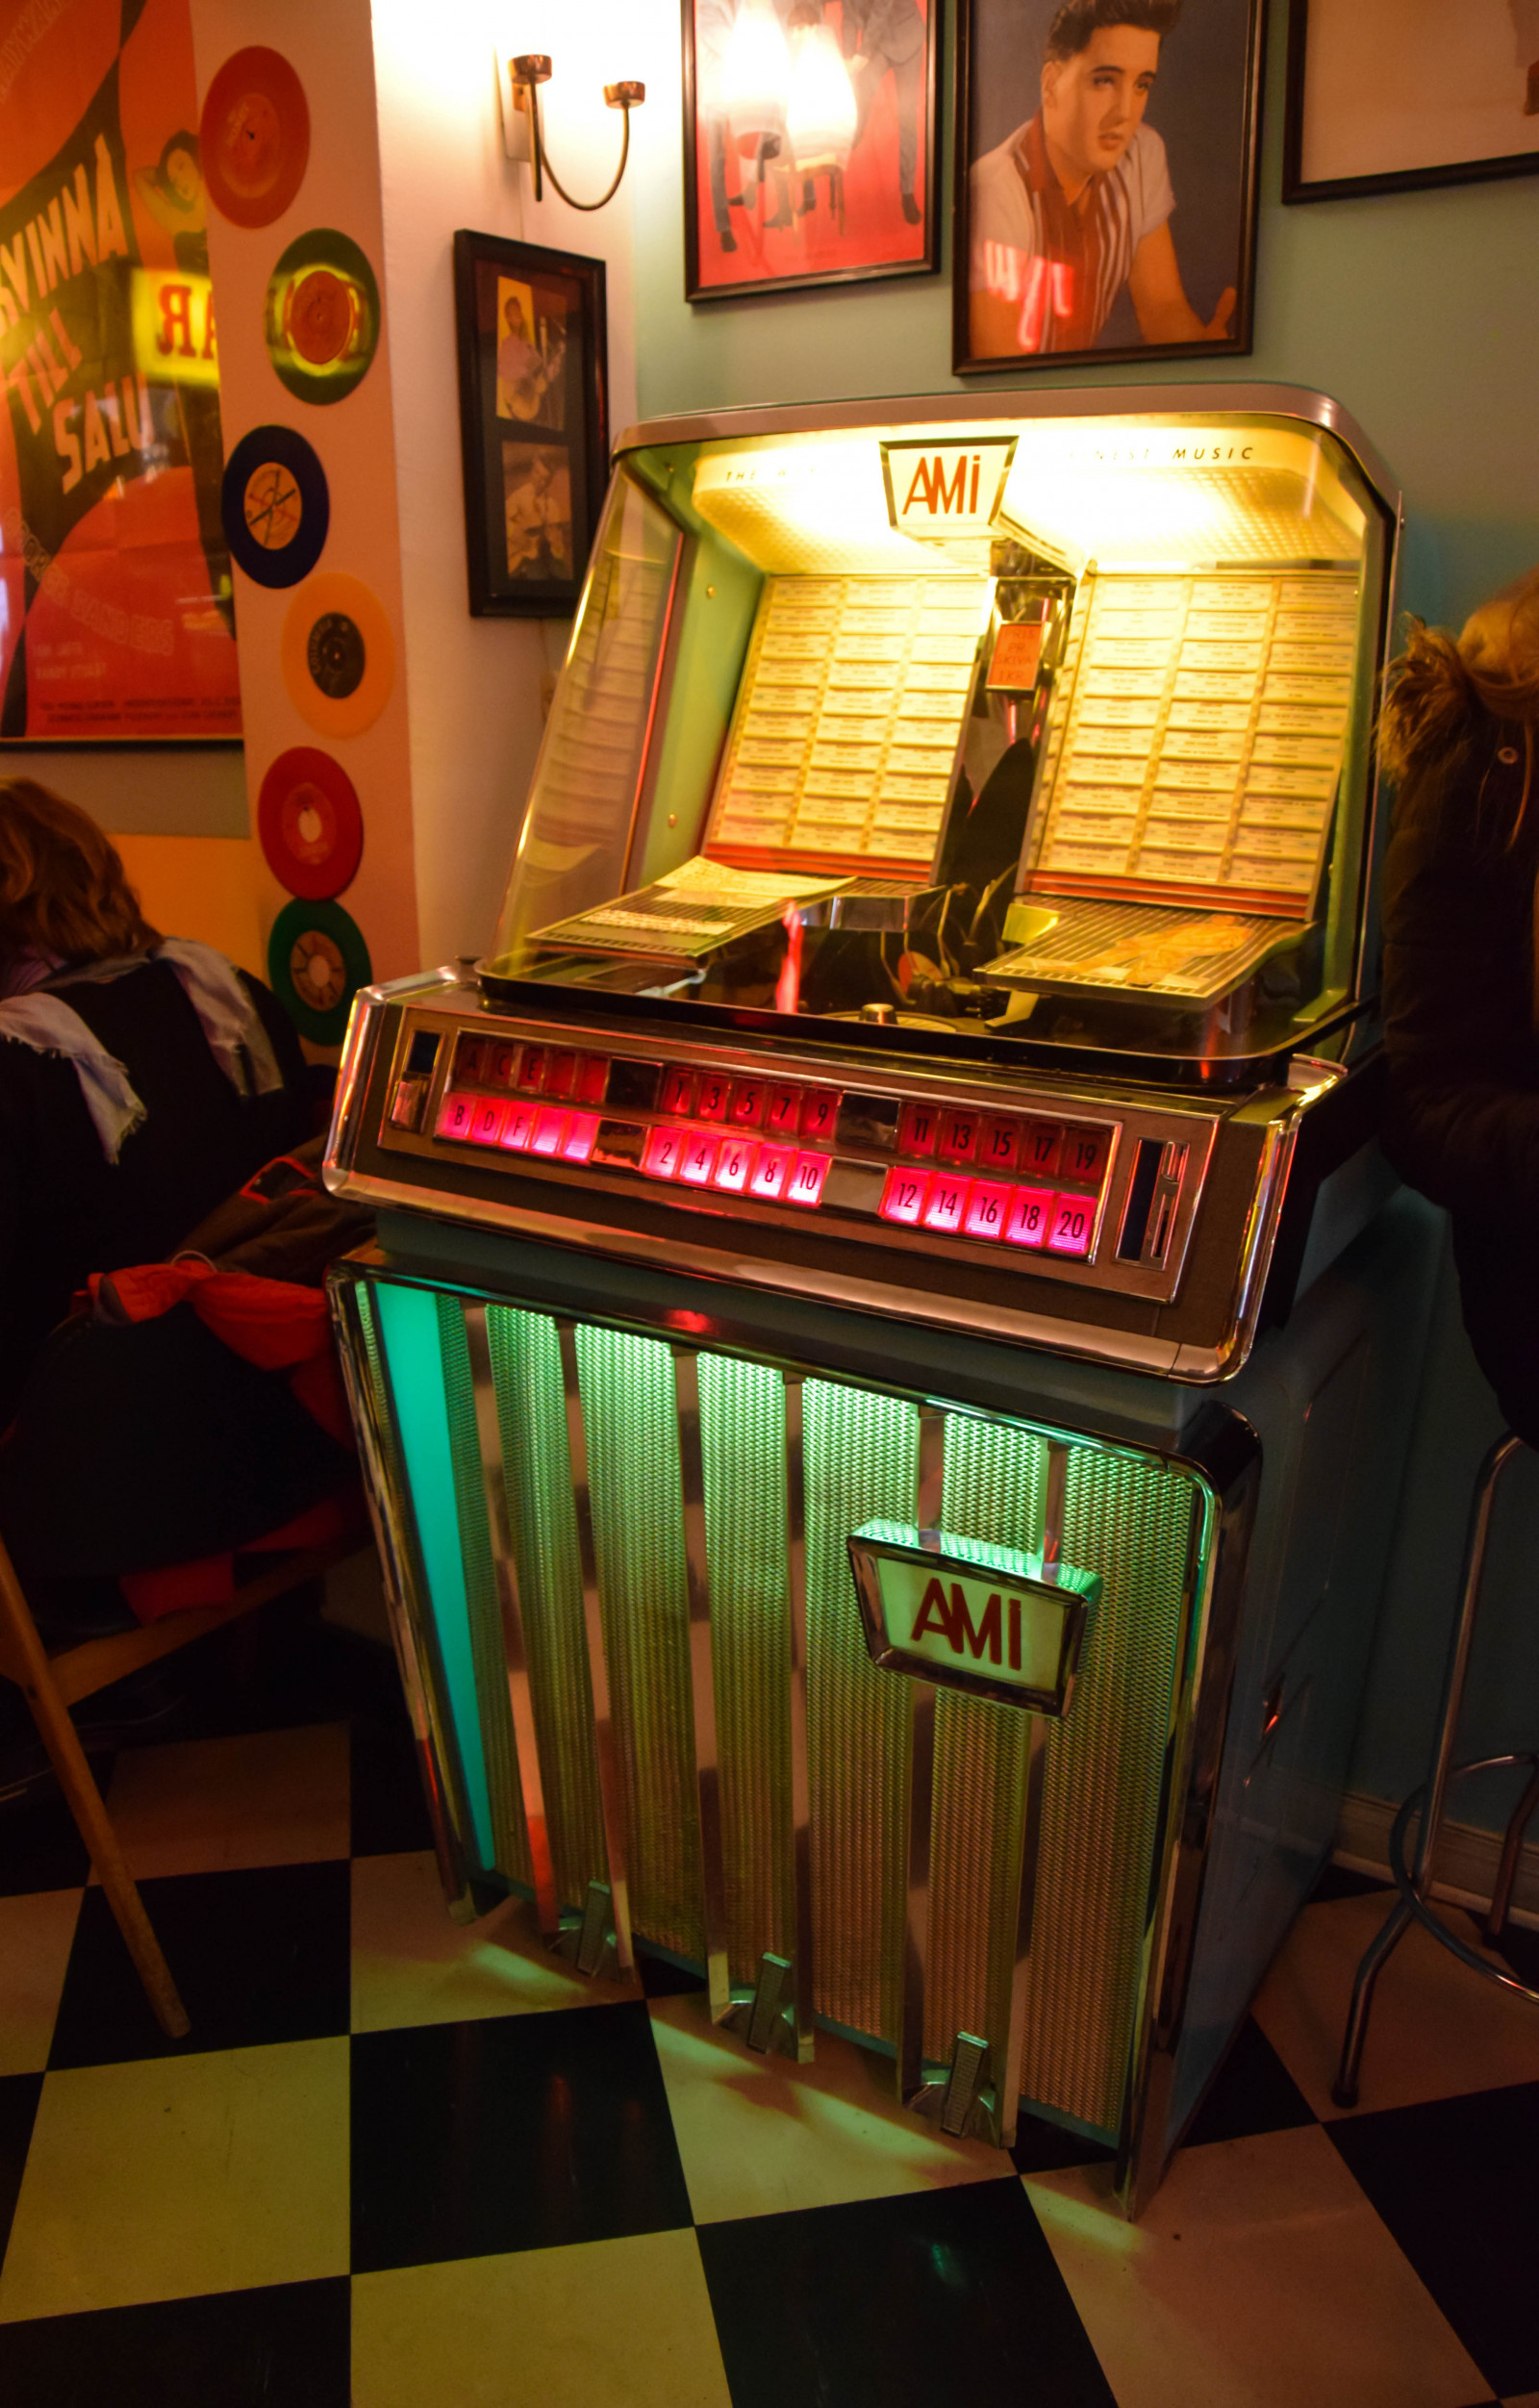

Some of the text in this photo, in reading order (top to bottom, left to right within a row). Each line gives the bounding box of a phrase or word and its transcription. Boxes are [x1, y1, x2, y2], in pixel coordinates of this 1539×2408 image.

[8, 307, 83, 435] TILL
[53, 369, 154, 494] SALU
[1173, 446, 1253, 461] MUSIC
[498, 1054, 507, 1077] C
[526, 1058, 536, 1080] E
[454, 1105, 524, 1137] B D F
[708, 1087, 719, 1109] 3
[744, 1092, 755, 1115] 5
[780, 1097, 792, 1121] 7
[818, 1103, 829, 1127] 9
[660, 1142, 819, 1191] 2 4 6 8 10
[914, 1117, 1097, 1170] 11 13 15 17 19
[897, 1182, 1085, 1239] 12 14 16 18 20
